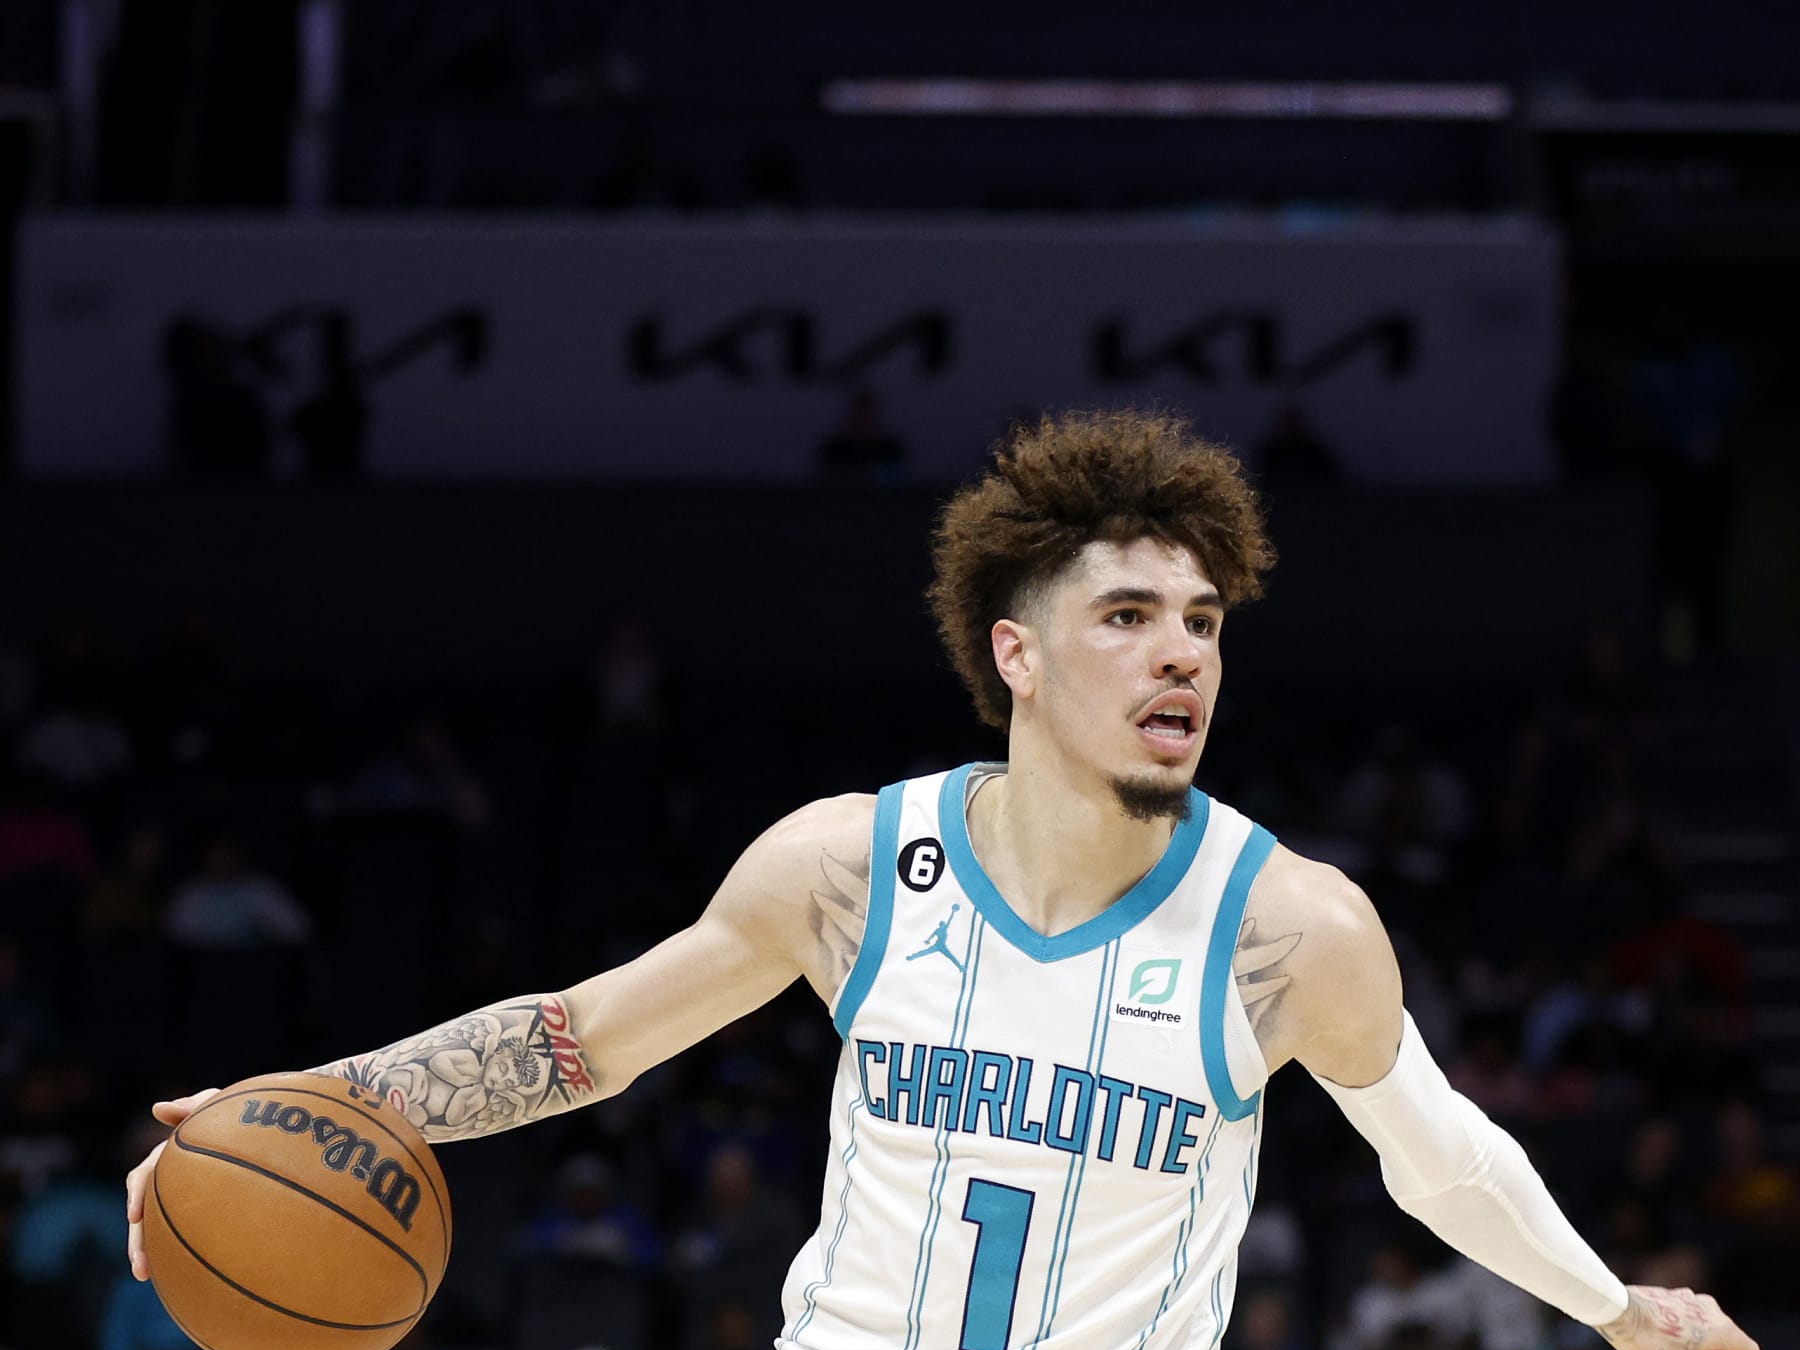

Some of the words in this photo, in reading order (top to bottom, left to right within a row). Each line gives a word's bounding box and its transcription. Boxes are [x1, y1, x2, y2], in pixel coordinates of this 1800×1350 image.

[908, 845, 938, 886] 6
[1115, 1003, 1182, 1023] lendingtree
[856, 1039, 1206, 1174] CHARLOTTE
[238, 1099, 422, 1234] Wilson
